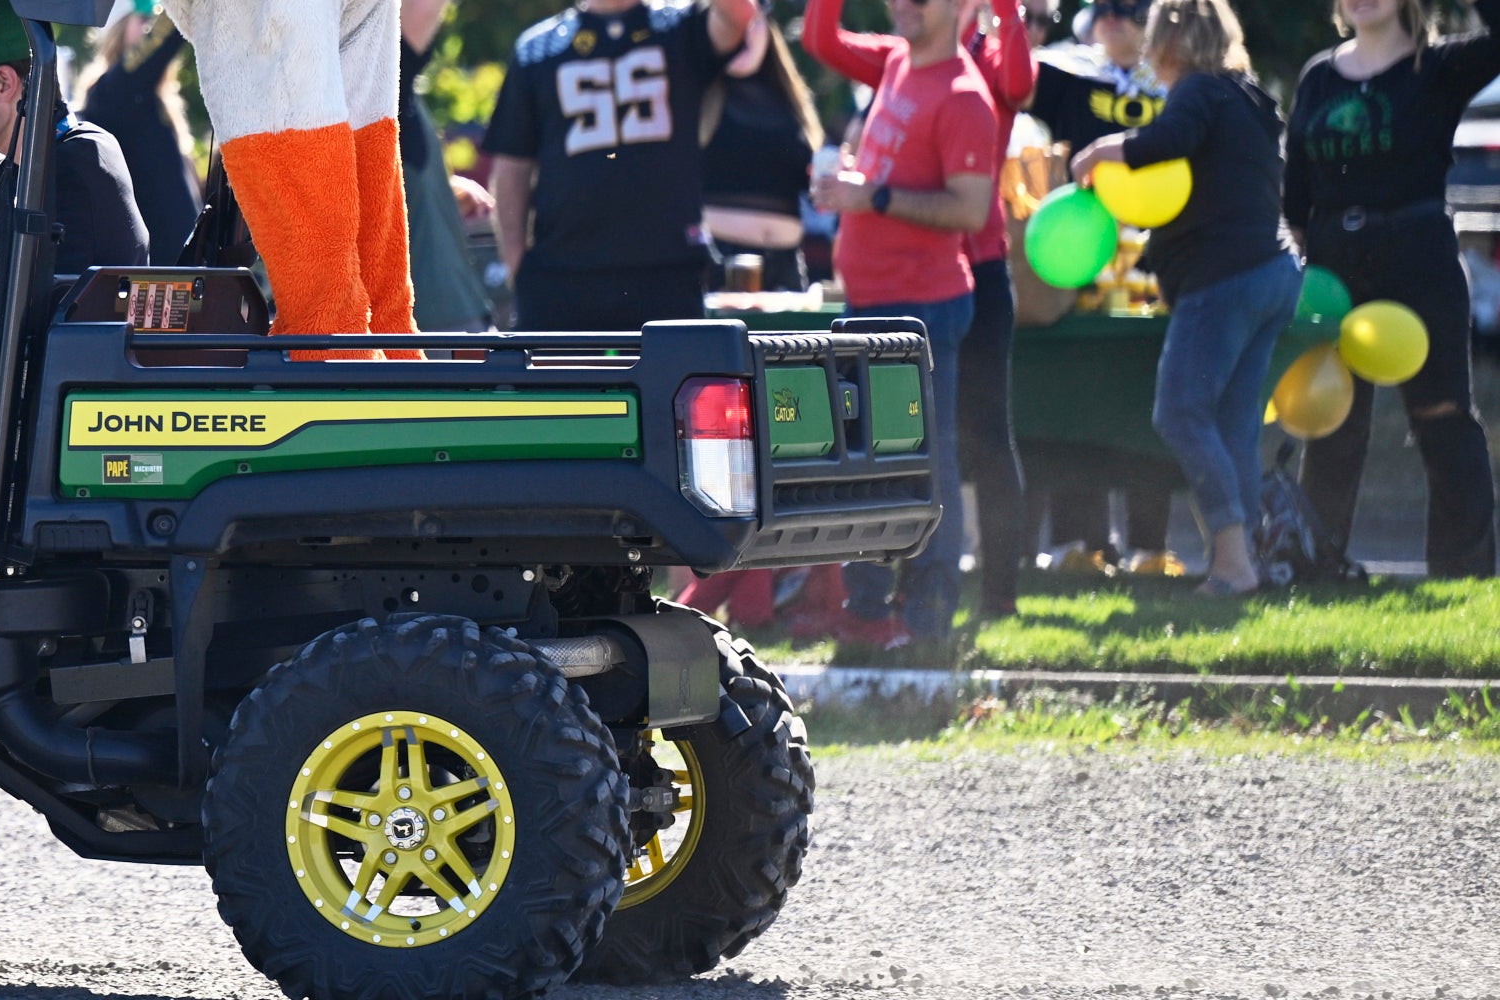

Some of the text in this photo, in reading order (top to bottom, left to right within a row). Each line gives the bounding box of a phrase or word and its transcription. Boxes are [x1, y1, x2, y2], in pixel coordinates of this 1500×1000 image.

[556, 46, 673, 157] 55
[774, 405, 796, 422] GATOR
[134, 465, 163, 473] MACHINERY
